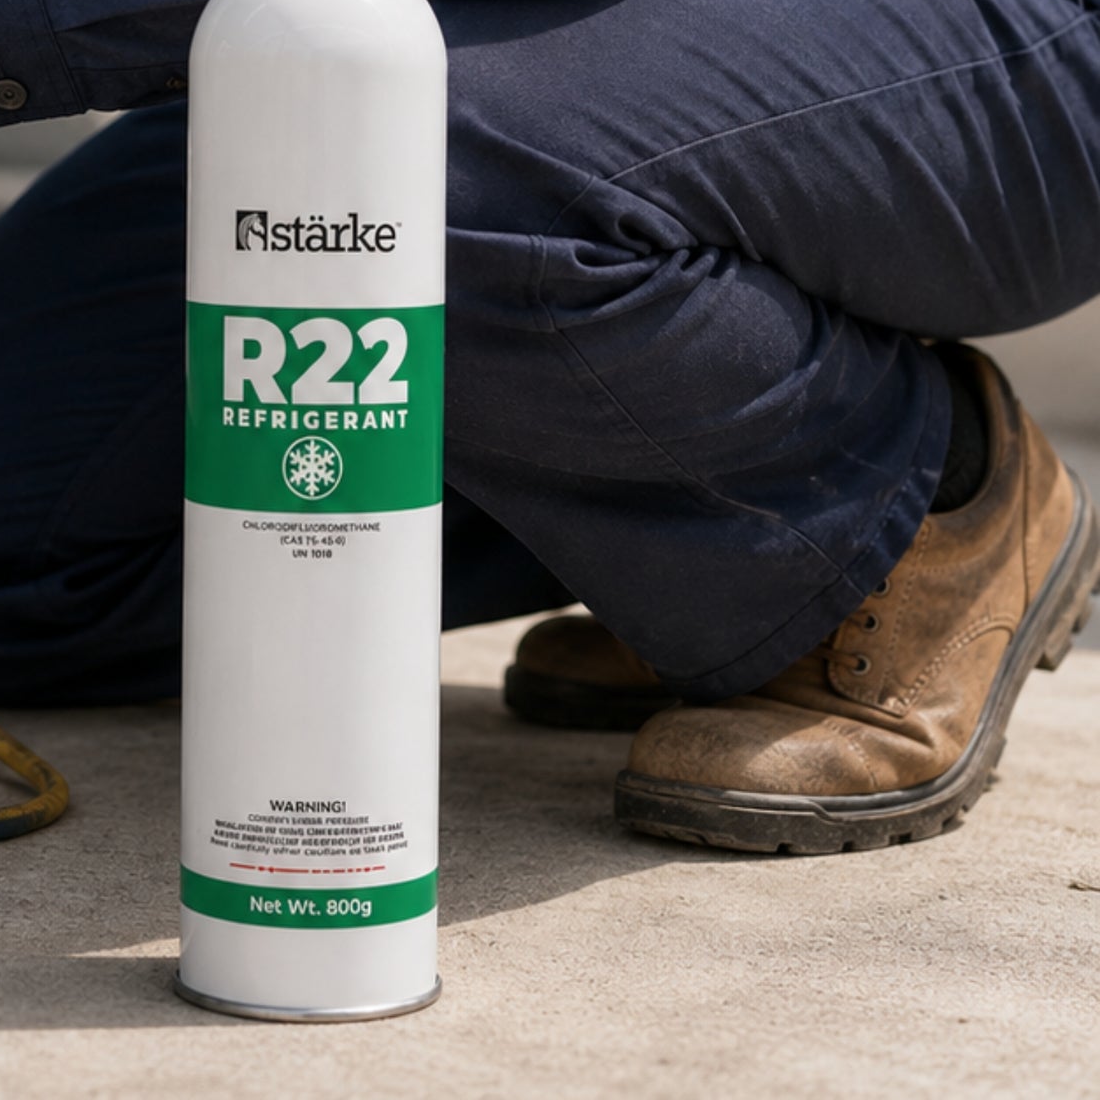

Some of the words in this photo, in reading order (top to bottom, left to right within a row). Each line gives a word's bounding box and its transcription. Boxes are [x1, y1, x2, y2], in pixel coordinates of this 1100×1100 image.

[223, 315, 409, 405] R22
[222, 406, 409, 431] REFRIGERANT
[270, 799, 347, 814] WARNING!
[249, 895, 283, 915] Net
[288, 899, 321, 916] Wt.
[326, 898, 373, 918] 800g
